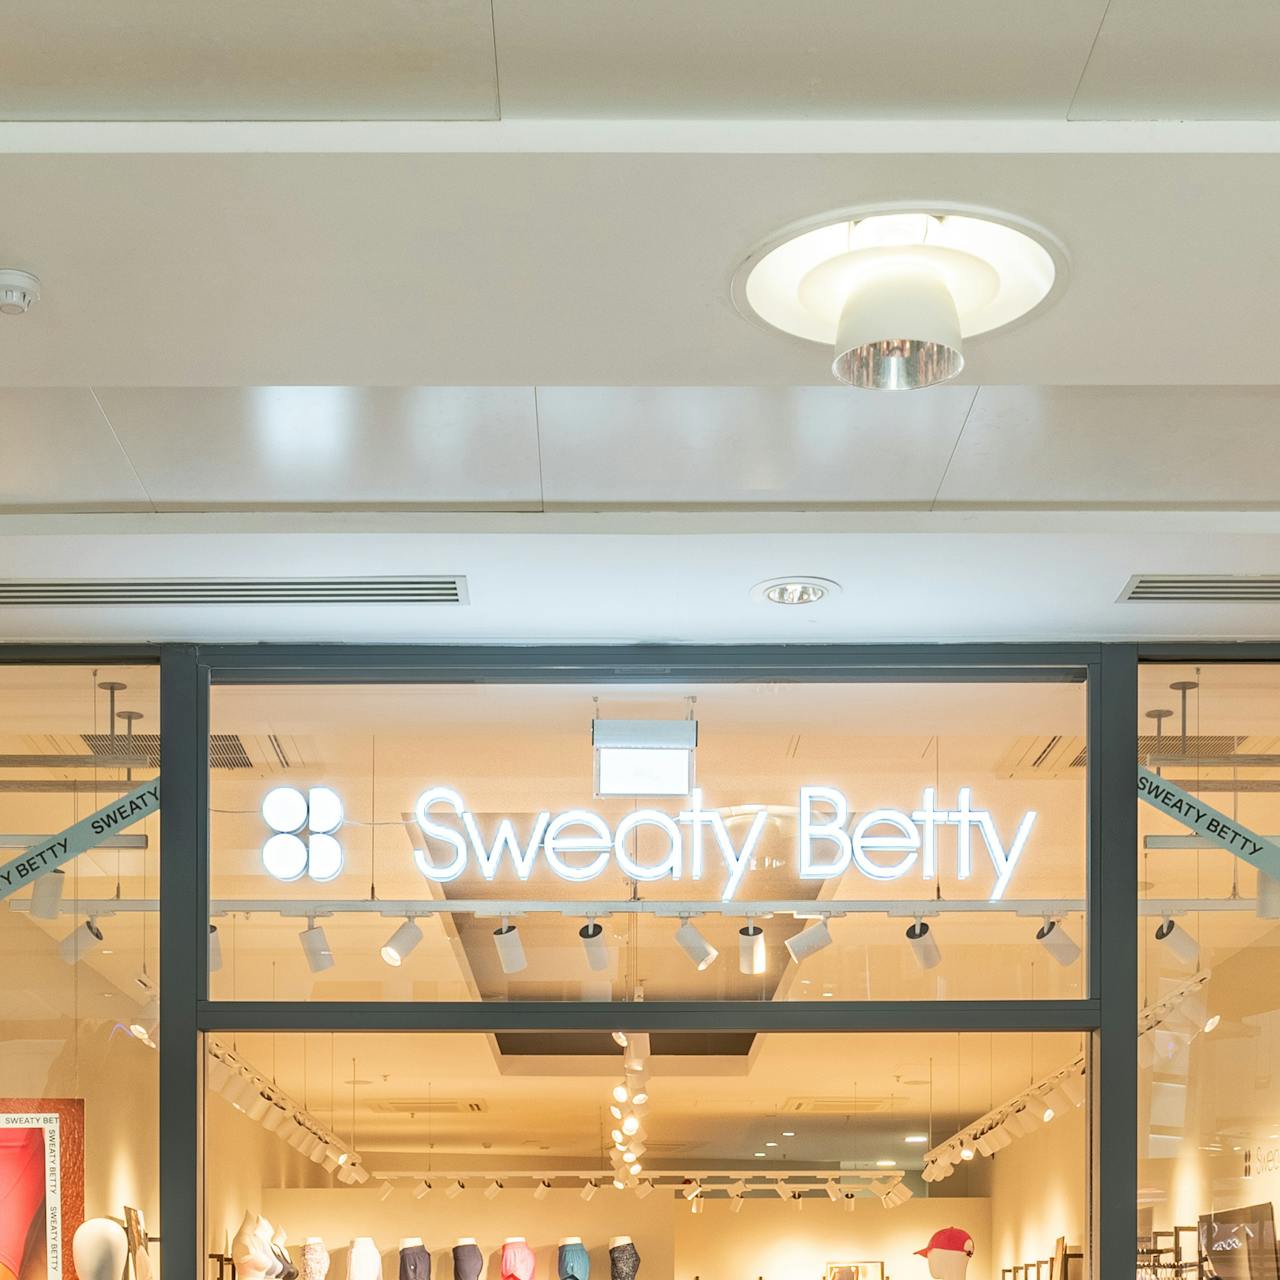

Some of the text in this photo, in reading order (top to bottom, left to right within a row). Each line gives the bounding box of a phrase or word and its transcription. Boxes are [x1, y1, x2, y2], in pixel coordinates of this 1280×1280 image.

[15, 837, 68, 879] BETTY
[91, 787, 161, 835] SWEATY
[1136, 776, 1207, 824] SWEATY
[1205, 817, 1264, 856] BETTY
[414, 786, 1038, 902] Sweaty Betty
[5, 1117, 40, 1125] SWEATY
[42, 1116, 59, 1124] BET
[48, 1129, 56, 1165] SWEATY
[49, 1167, 57, 1195] BETTY
[50, 1207, 58, 1242] SWEATY
